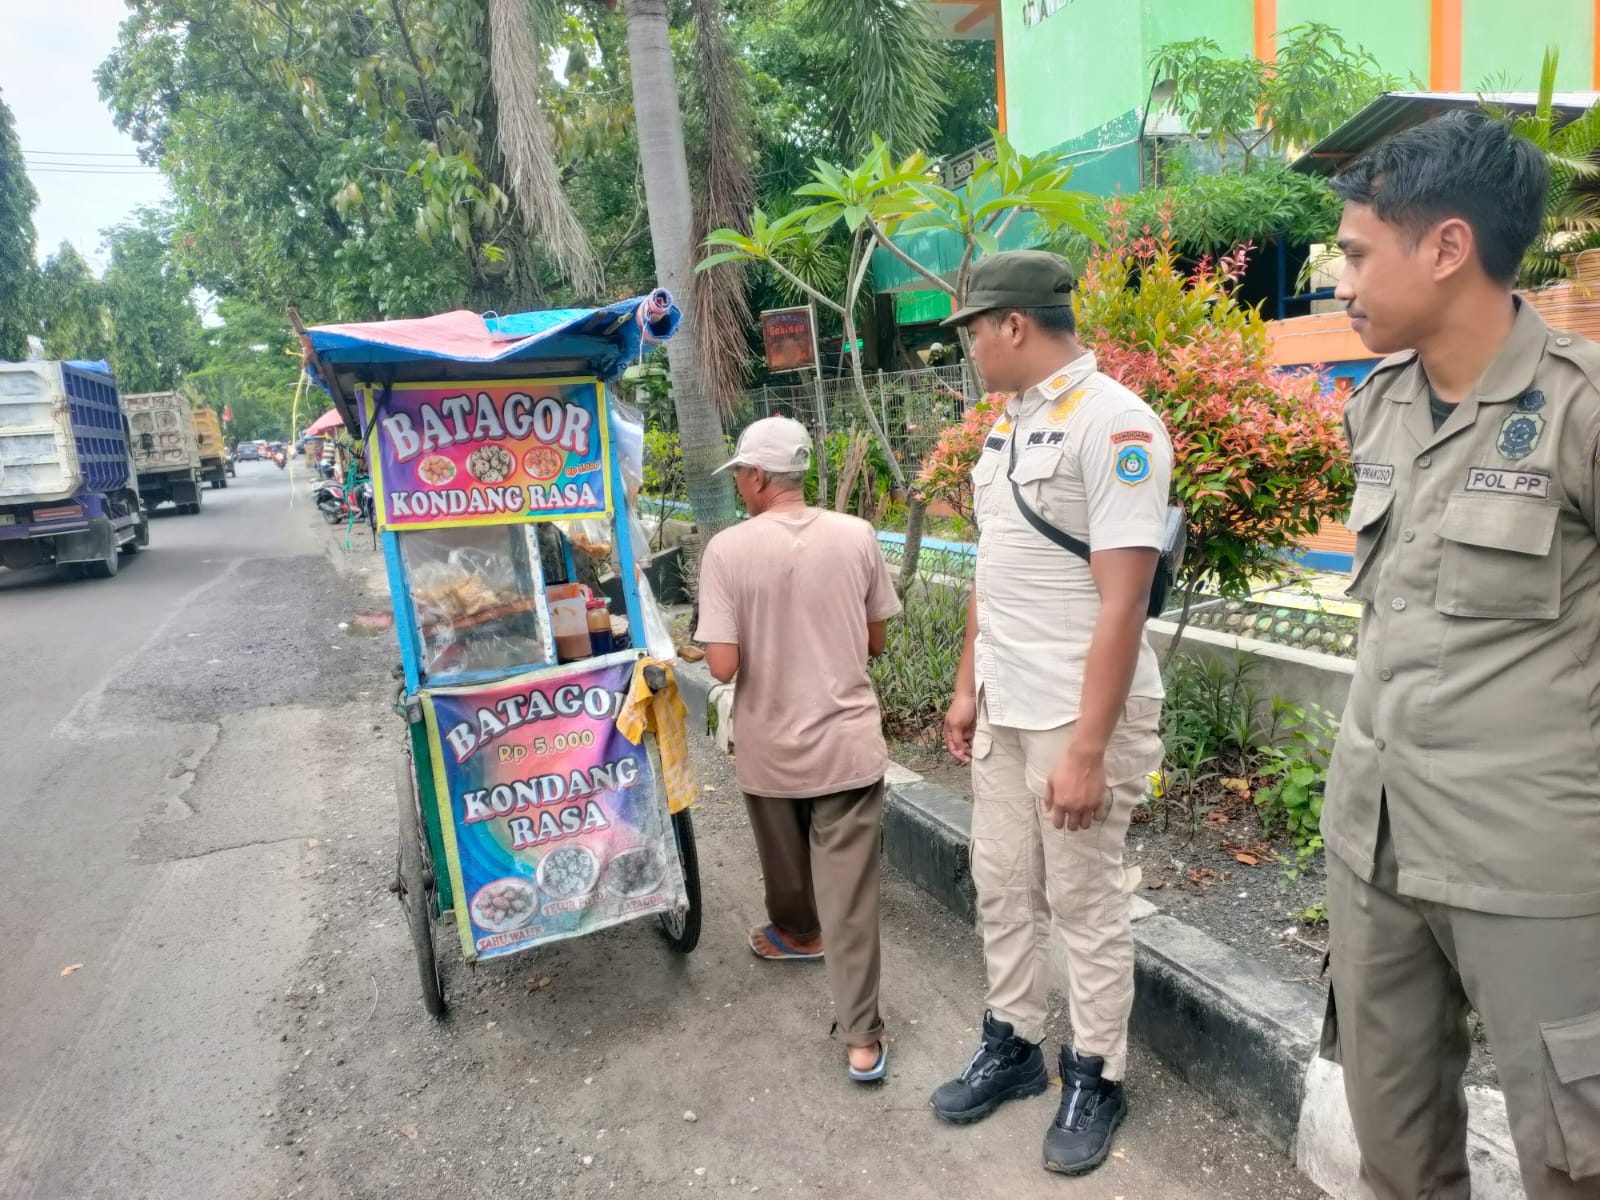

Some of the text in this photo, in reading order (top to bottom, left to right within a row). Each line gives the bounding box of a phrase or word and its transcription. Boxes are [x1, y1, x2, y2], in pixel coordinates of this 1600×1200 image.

[383, 392, 591, 463] BATAGOR
[1046, 431, 1065, 445] PP
[1472, 472, 1542, 492] POL PP
[391, 483, 598, 518] KONDANG RASA
[534, 730, 595, 755] 5.000
[464, 757, 640, 823] KONDANG
[509, 801, 611, 850] RASA
